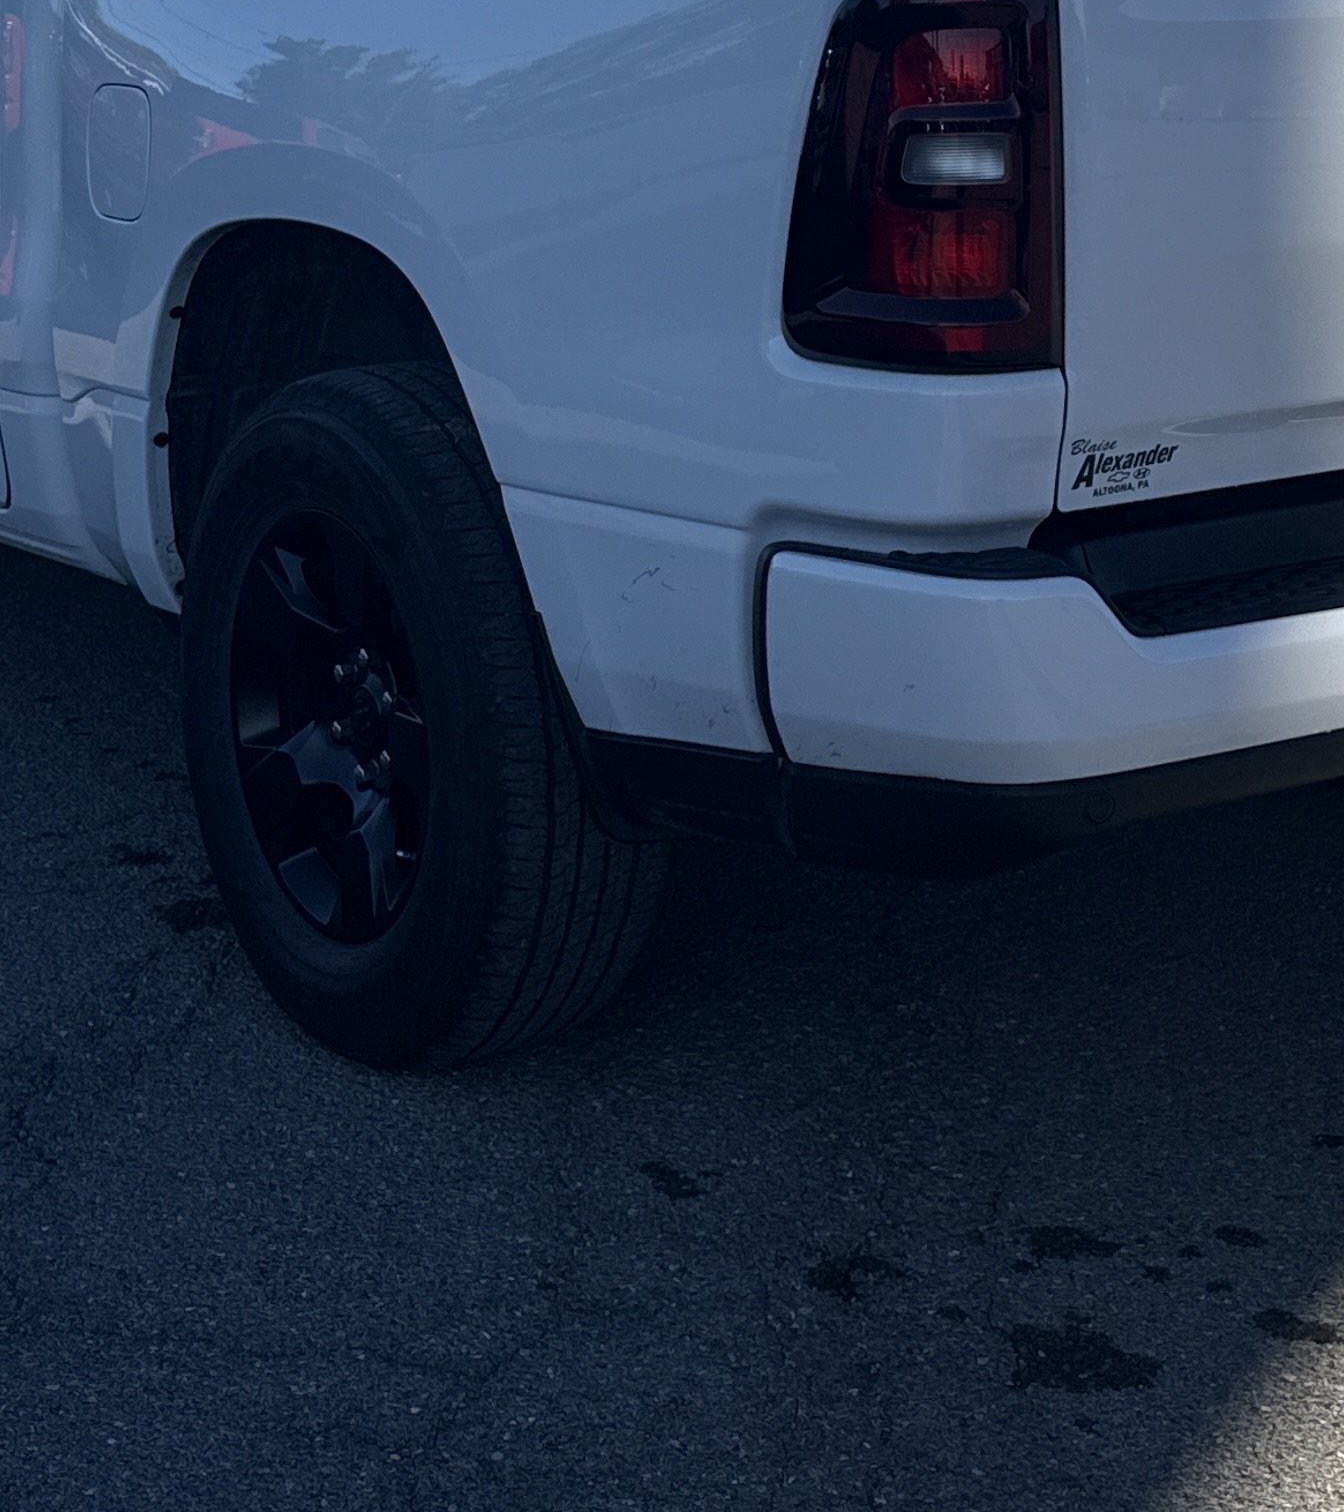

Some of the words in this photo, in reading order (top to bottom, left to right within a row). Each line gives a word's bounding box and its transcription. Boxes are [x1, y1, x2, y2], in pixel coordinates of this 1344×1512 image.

[1070, 438, 1118, 456] Blaise
[1071, 443, 1180, 491] Alexander
[1137, 479, 1150, 489] PA
